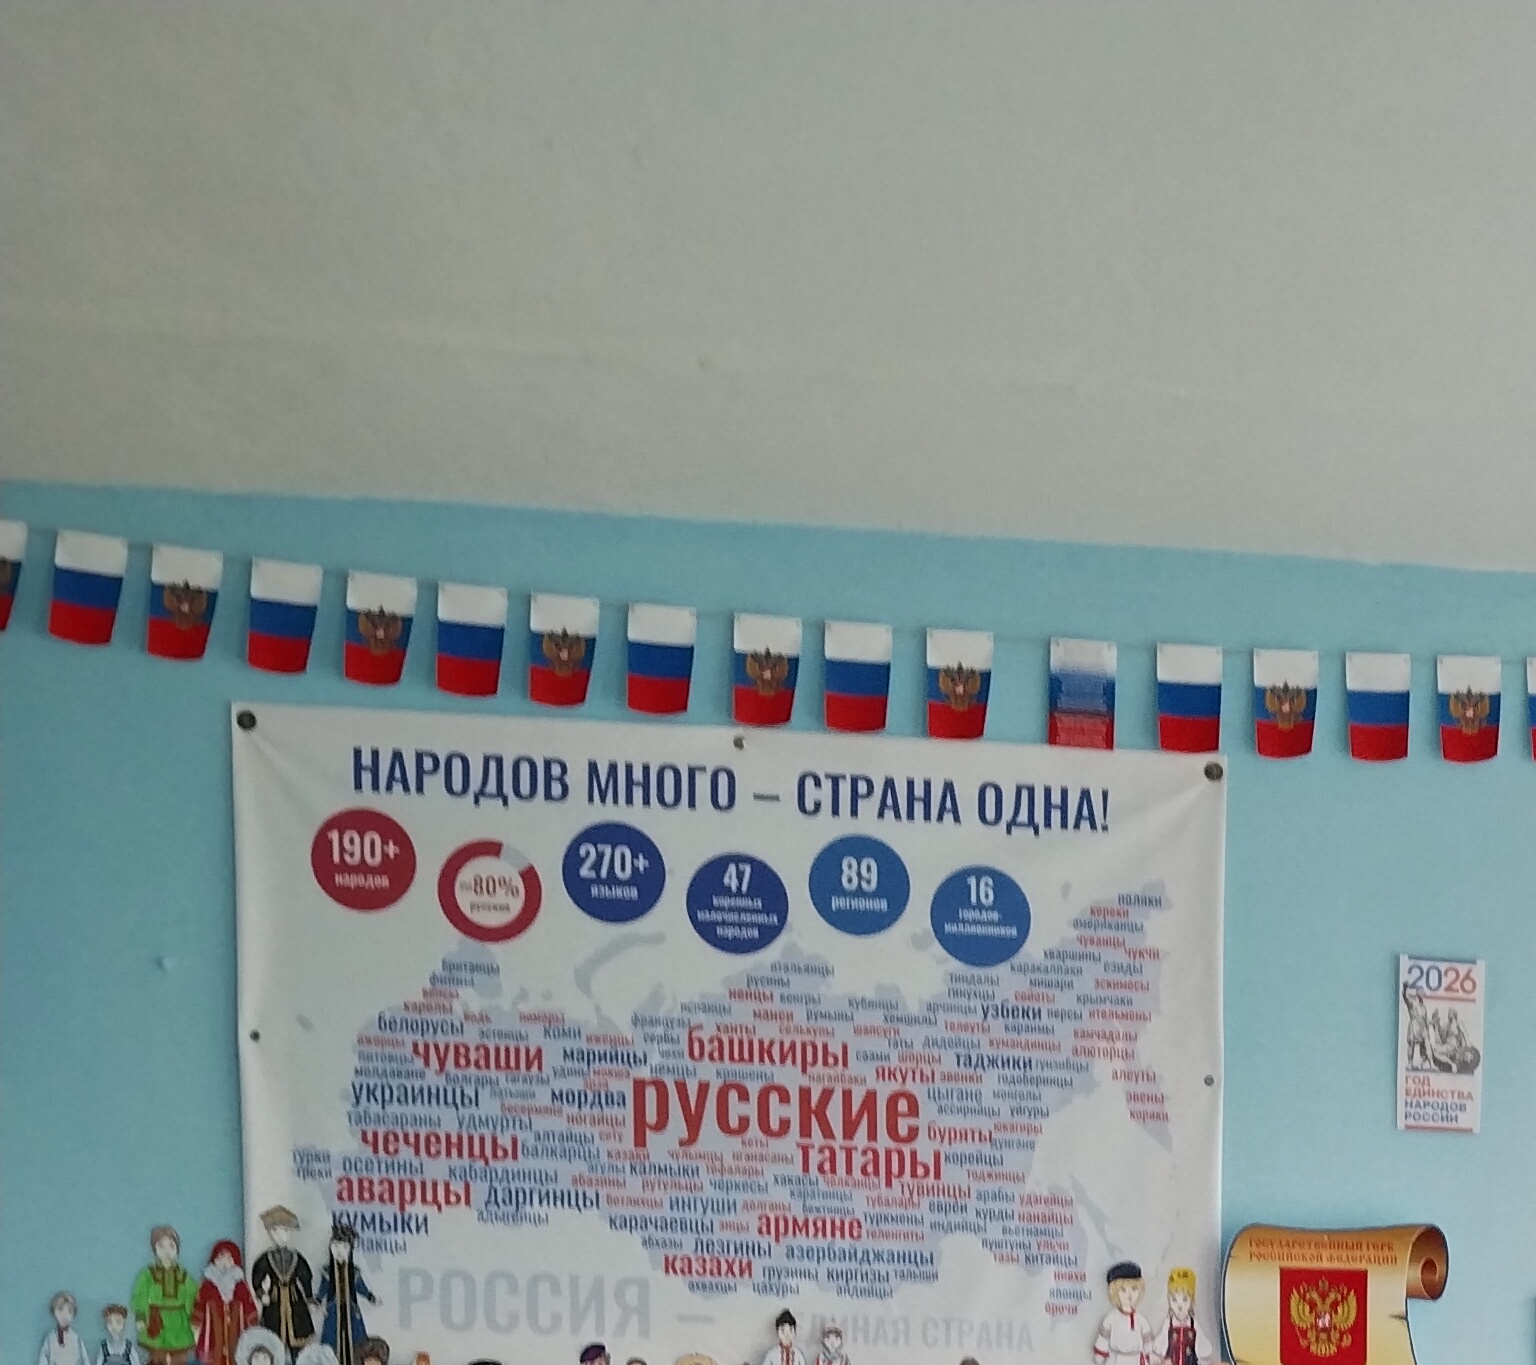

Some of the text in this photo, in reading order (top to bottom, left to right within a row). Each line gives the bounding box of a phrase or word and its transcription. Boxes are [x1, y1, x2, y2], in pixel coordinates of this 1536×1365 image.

[352, 745, 570, 808] НАРОДОВ
[587, 758, 737, 811] МНОГО
[797, 770, 962, 824] СТРАНА
[977, 781, 1110, 837] ОДНА!
[327, 828, 401, 867] 190+
[579, 841, 650, 881] 270+
[334, 871, 390, 890] народов
[723, 862, 752, 894] 47
[841, 855, 879, 893] 89
[591, 883, 639, 901] языков
[966, 875, 995, 907] 16
[831, 894, 888, 914] регионов
[1407, 964, 1477, 995] 2026
[728, 987, 774, 1004] ненцы
[979, 998, 1042, 1022] узбеки
[377, 1014, 464, 1037] белорусы
[411, 1041, 544, 1075] чуваши
[562, 1046, 648, 1067] марийцы
[686, 1022, 848, 1075] башкиры
[954, 1051, 1033, 1071] таджики
[876, 1065, 936, 1085] якуты
[1111, 1067, 1157, 1083] алеуты
[1405, 1074, 1431, 1087] ГОД
[351, 1081, 480, 1110] украинцы
[550, 1087, 627, 1111] мордва
[927, 1087, 983, 1103] цыгане
[1404, 1086, 1474, 1101] ЕДИНСТВА
[632, 1077, 920, 1149] русские
[1404, 1099, 1467, 1113] НАРОДОВ
[456, 1113, 532, 1132] удмурты
[1404, 1111, 1459, 1124] РОССИИ
[926, 1124, 993, 1147] буряты
[361, 1128, 519, 1167] чеченцы
[520, 1141, 600, 1163] балкарцы
[944, 1149, 1004, 1167] корейцы
[342, 1155, 424, 1175] осетины
[448, 1164, 558, 1186] кабардинцы
[629, 1161, 700, 1178] калмыки
[795, 1141, 941, 1189] татары
[336, 1175, 471, 1214] аварцы
[485, 1185, 600, 1214] даргинцы
[899, 1181, 971, 1202] тувинцы
[669, 1194, 737, 1216] ингуши
[331, 1209, 430, 1236] кумыки
[608, 1213, 714, 1235] карачаевцы
[757, 1213, 863, 1245] армяне
[693, 1238, 772, 1260] лезгины
[785, 1244, 934, 1267] азербайджанцы
[664, 1254, 753, 1280] казахи
[762, 1265, 818, 1283] грузины
[826, 1267, 889, 1285] киргизы
[399, 1266, 652, 1340] РОССИЯ
[921, 1317, 1034, 1353] СТРАНА
